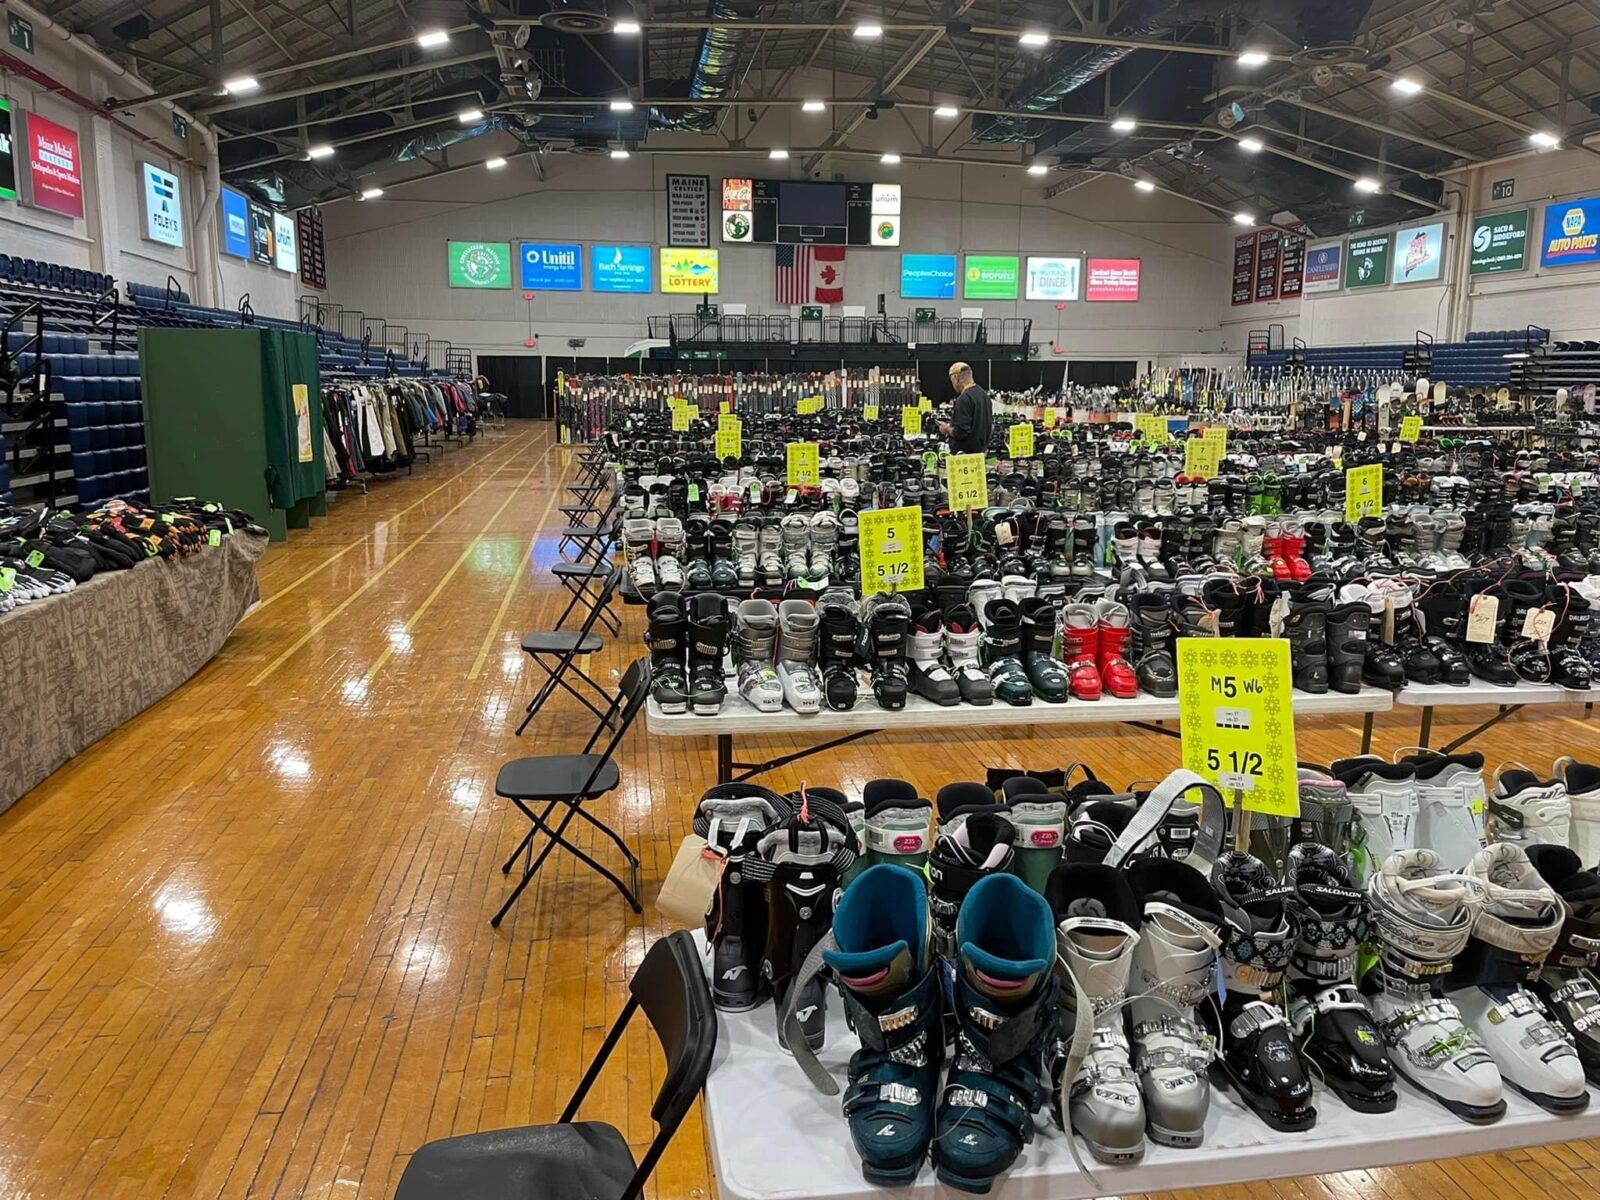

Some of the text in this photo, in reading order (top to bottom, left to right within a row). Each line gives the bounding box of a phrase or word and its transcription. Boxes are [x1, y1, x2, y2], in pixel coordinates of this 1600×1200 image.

[1501, 186, 1512, 198] 10
[154, 213, 178, 232] FOLEY'S
[1357, 215, 1362, 225] 9
[1566, 215, 1582, 228] NAPA
[1493, 225, 1508, 234] SACO
[1493, 230, 1526, 241] BIDDEFORD
[1548, 234, 1598, 252] AUTO PARTS
[542, 249, 575, 265] Unitil
[599, 262, 645, 274] Bath Savings
[903, 269, 954, 278] PeoplesChoice
[1307, 263, 1338, 273] CANDLEWOOD
[982, 271, 1015, 280] BIOFUELS
[669, 278, 711, 287] LOTTERY
[1039, 277, 1066, 287] DINER
[1362, 477, 1368, 486] 6
[958, 489, 978, 500] 6 1/2
[1355, 499, 1374, 510] 6 1/2
[887, 527, 895, 539] 5
[877, 562, 909, 576] 5 1/2
[1207, 748, 1263, 776] 5 1/2
[1315, 886, 1362, 898] SALOMON
